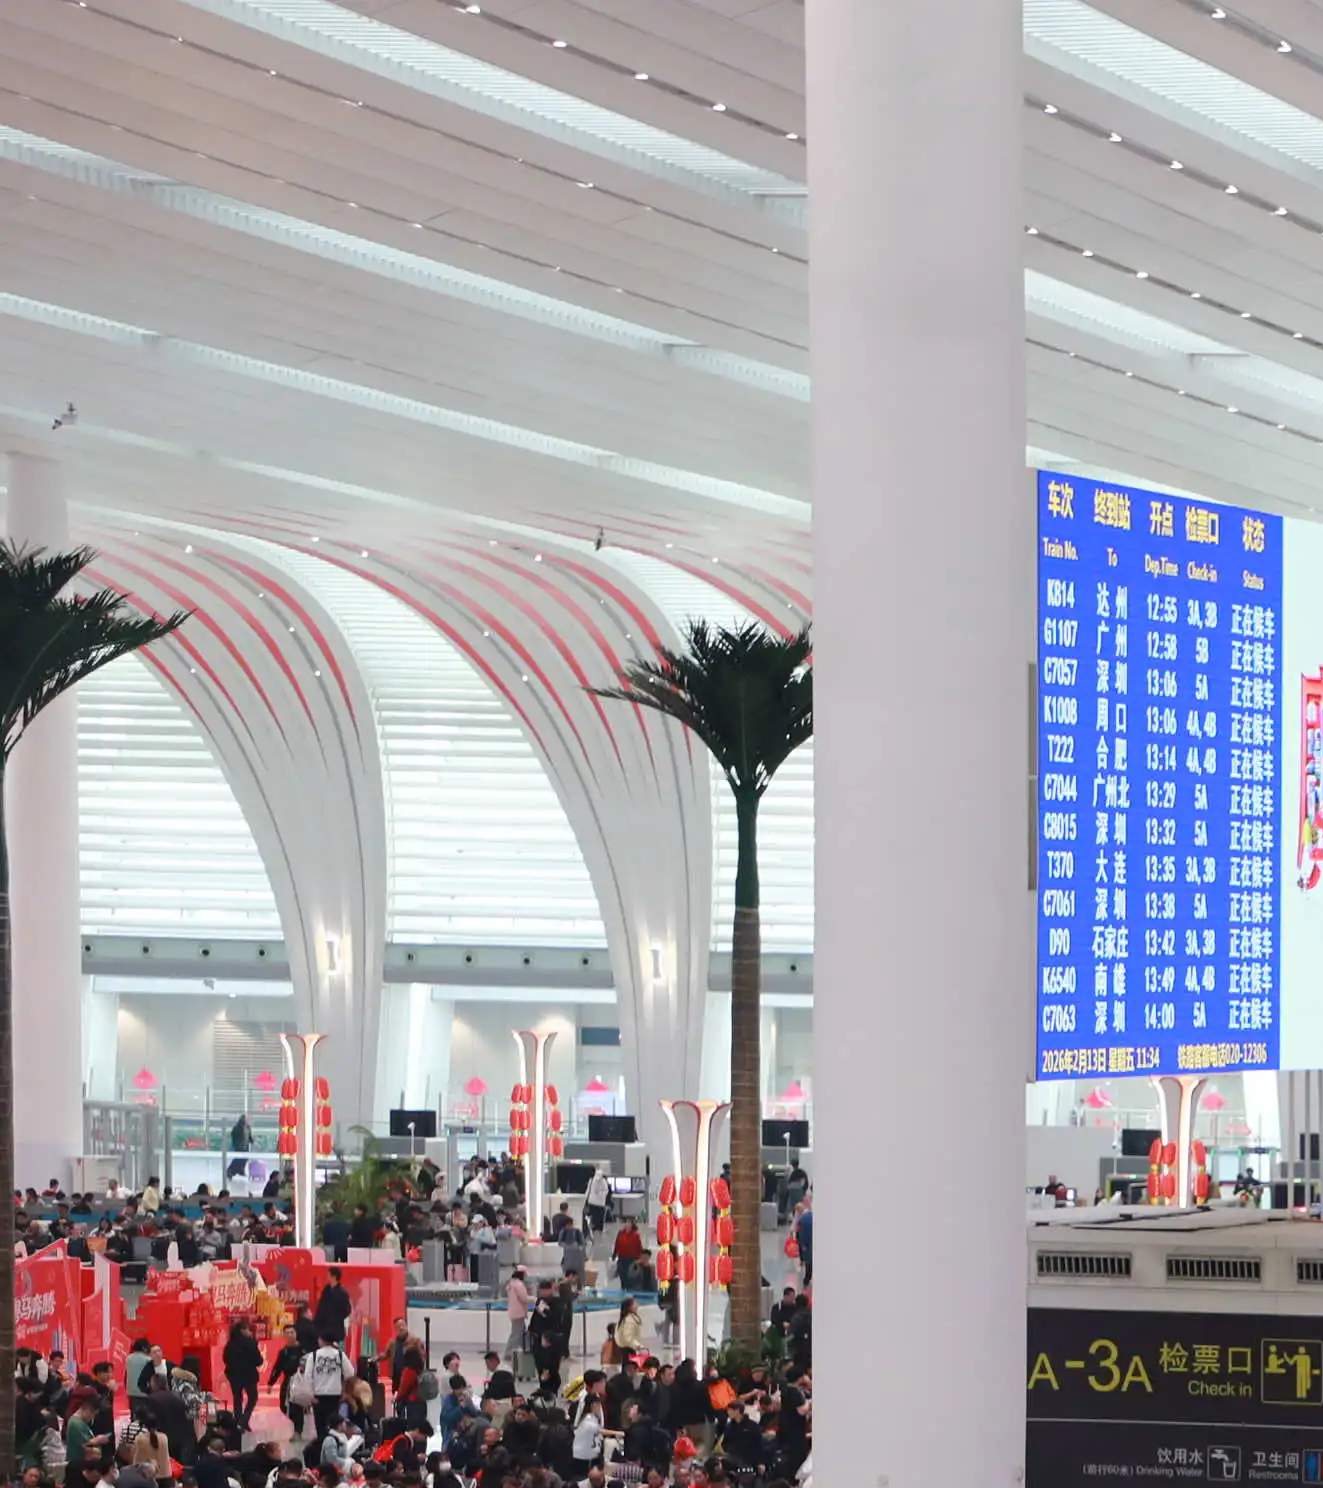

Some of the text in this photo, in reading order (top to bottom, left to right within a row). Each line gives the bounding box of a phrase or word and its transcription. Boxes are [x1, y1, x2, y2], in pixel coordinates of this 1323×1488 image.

[1048, 481, 1264, 552] 车次 终到站 开点 检票口 状态
[1043, 538, 1063, 557] Train
[1065, 542, 1078, 559] No.
[1108, 548, 1117, 566] To
[1188, 563, 1217, 582] Check-in
[1148, 595, 1177, 622] 12:55
[1231, 605, 1274, 641] 正在候车
[1148, 632, 1177, 659] 12:58
[1196, 638, 1208, 663] 5B
[1231, 640, 1274, 677] 正在候车
[1147, 670, 1177, 697] 13:06
[1196, 674, 1208, 699] 5A
[1231, 676, 1274, 710] 正在候车
[1147, 707, 1176, 734] 13:06
[1231, 713, 1273, 745] 正在候车
[1147, 744, 1176, 770] 13:14
[1231, 749, 1273, 781] 正在候车
[1093, 774, 1129, 807] 广州北
[1147, 782, 1175, 807] 13:29
[1195, 784, 1207, 809] 5A
[1230, 784, 1273, 817] 正在候车
[1146, 820, 1175, 844] 13:32
[1195, 821, 1207, 845] 5A
[1230, 821, 1273, 852] 正在候车
[1146, 856, 1175, 881] 13:35
[1230, 856, 1273, 887] 正在候车
[1146, 893, 1175, 918] 13:38
[1195, 894, 1207, 918] 5A
[1230, 892, 1272, 923] 正在候车
[1092, 925, 1128, 958] 石家庄
[1145, 930, 1174, 955] 13:42
[1230, 929, 1272, 958] 正在候车
[1145, 967, 1174, 992] 13:49
[1229, 963, 1272, 993] 正在候车
[1145, 1003, 1174, 1028] 14:00
[1194, 1002, 1205, 1027] 5A
[1229, 998, 1272, 1029] 正在候车
[1137, 1047, 1160, 1068] 11:34
[1159, 1342, 1252, 1374] 检票口
[1188, 1380, 1252, 1396] Check in
[1136, 1467, 1174, 1479] Drinking
[1176, 1467, 1203, 1477] Water
[1249, 1469, 1298, 1481] Restrooms
[1157, 1448, 1299, 1468] 饮用水 卫生间
